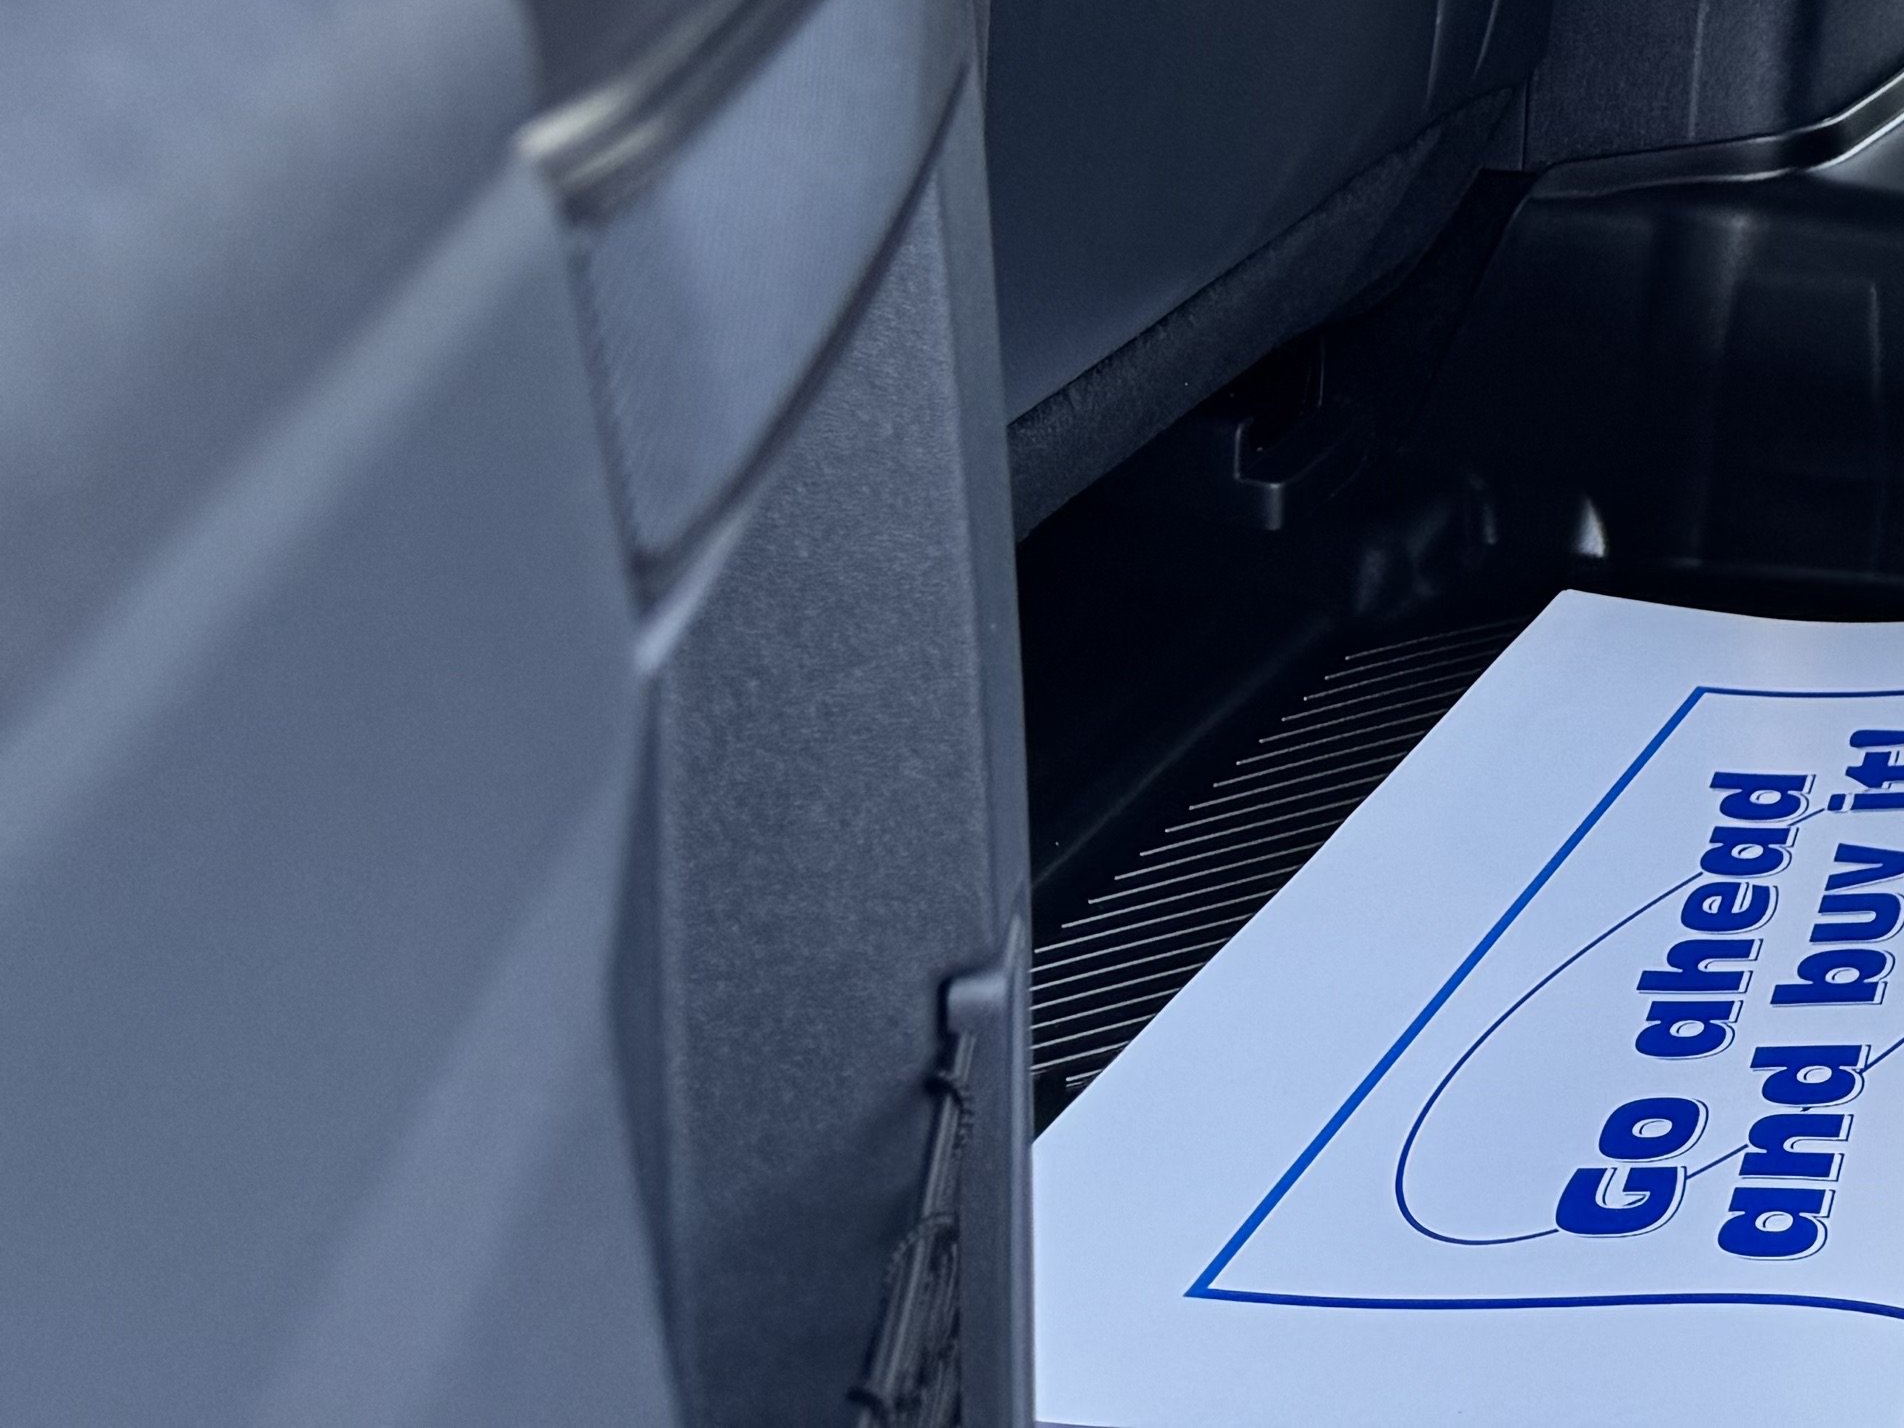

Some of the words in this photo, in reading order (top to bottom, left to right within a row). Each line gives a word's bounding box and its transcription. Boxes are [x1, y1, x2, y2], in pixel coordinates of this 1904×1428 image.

[1556, 1096, 1709, 1239] Go
[1635, 771, 1816, 1060] ahead
[1717, 1044, 1872, 1261] and
